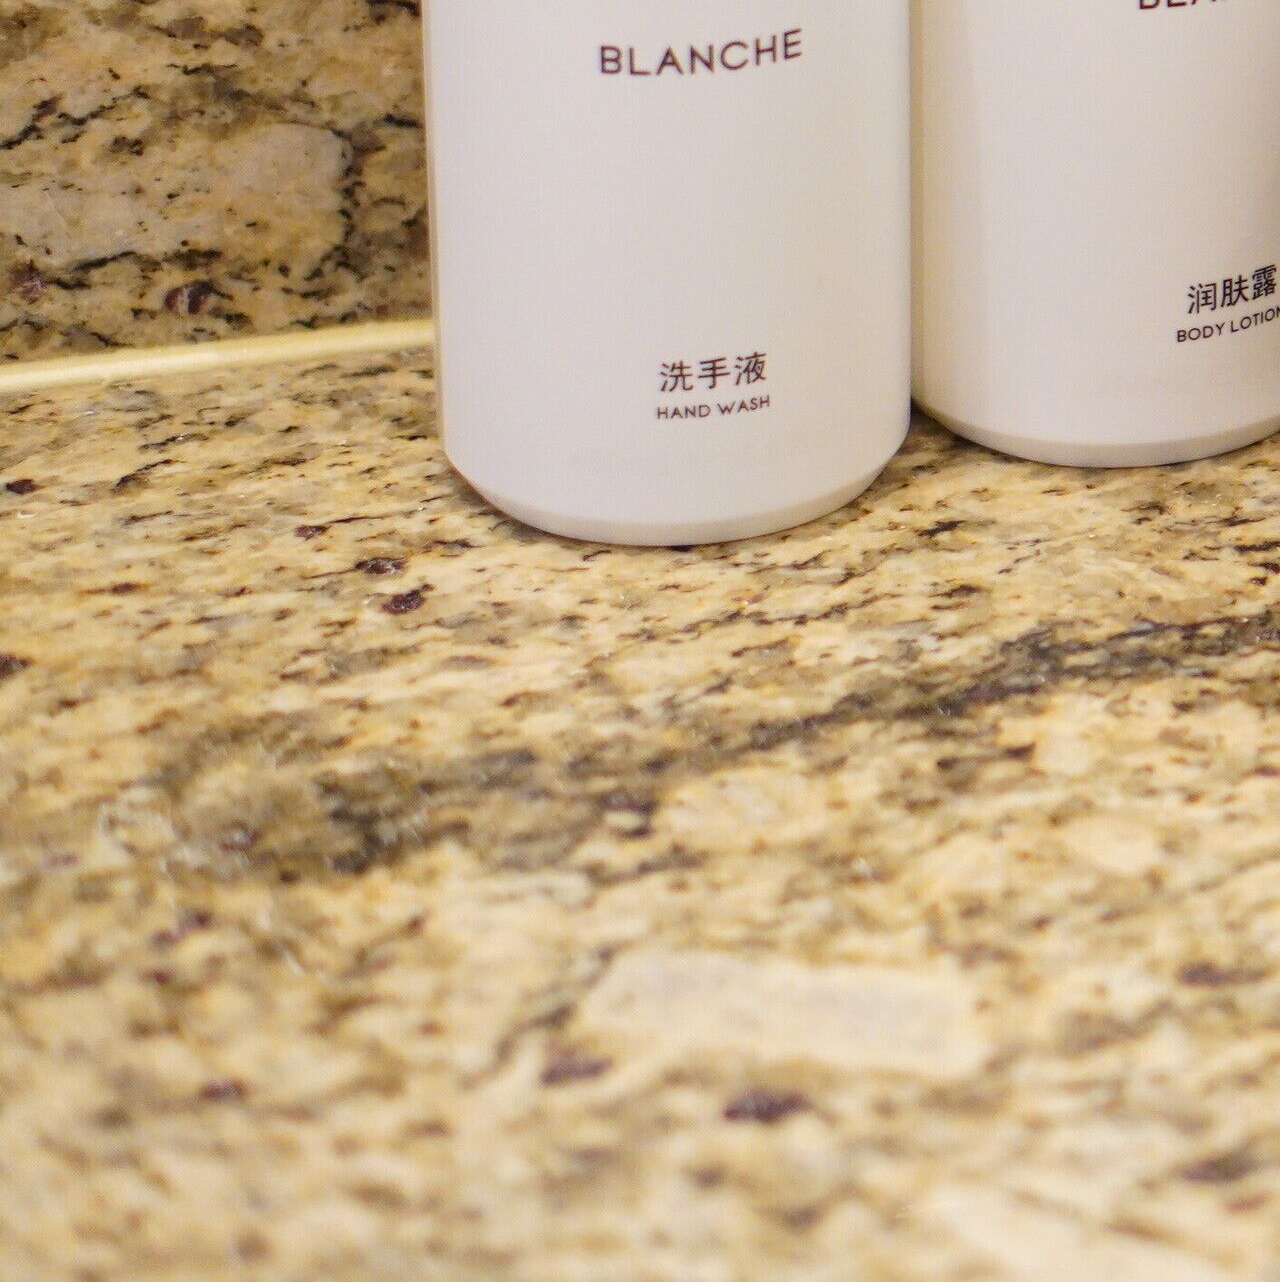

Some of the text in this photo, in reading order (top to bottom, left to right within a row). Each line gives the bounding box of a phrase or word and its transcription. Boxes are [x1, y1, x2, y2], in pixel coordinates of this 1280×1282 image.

[600, 27, 803, 77] BLANCHE
[1187, 264, 1278, 314] 润肤露
[1176, 322, 1226, 343] BODY
[660, 351, 767, 392] 洗手液
[656, 395, 771, 420] HAND WASH
